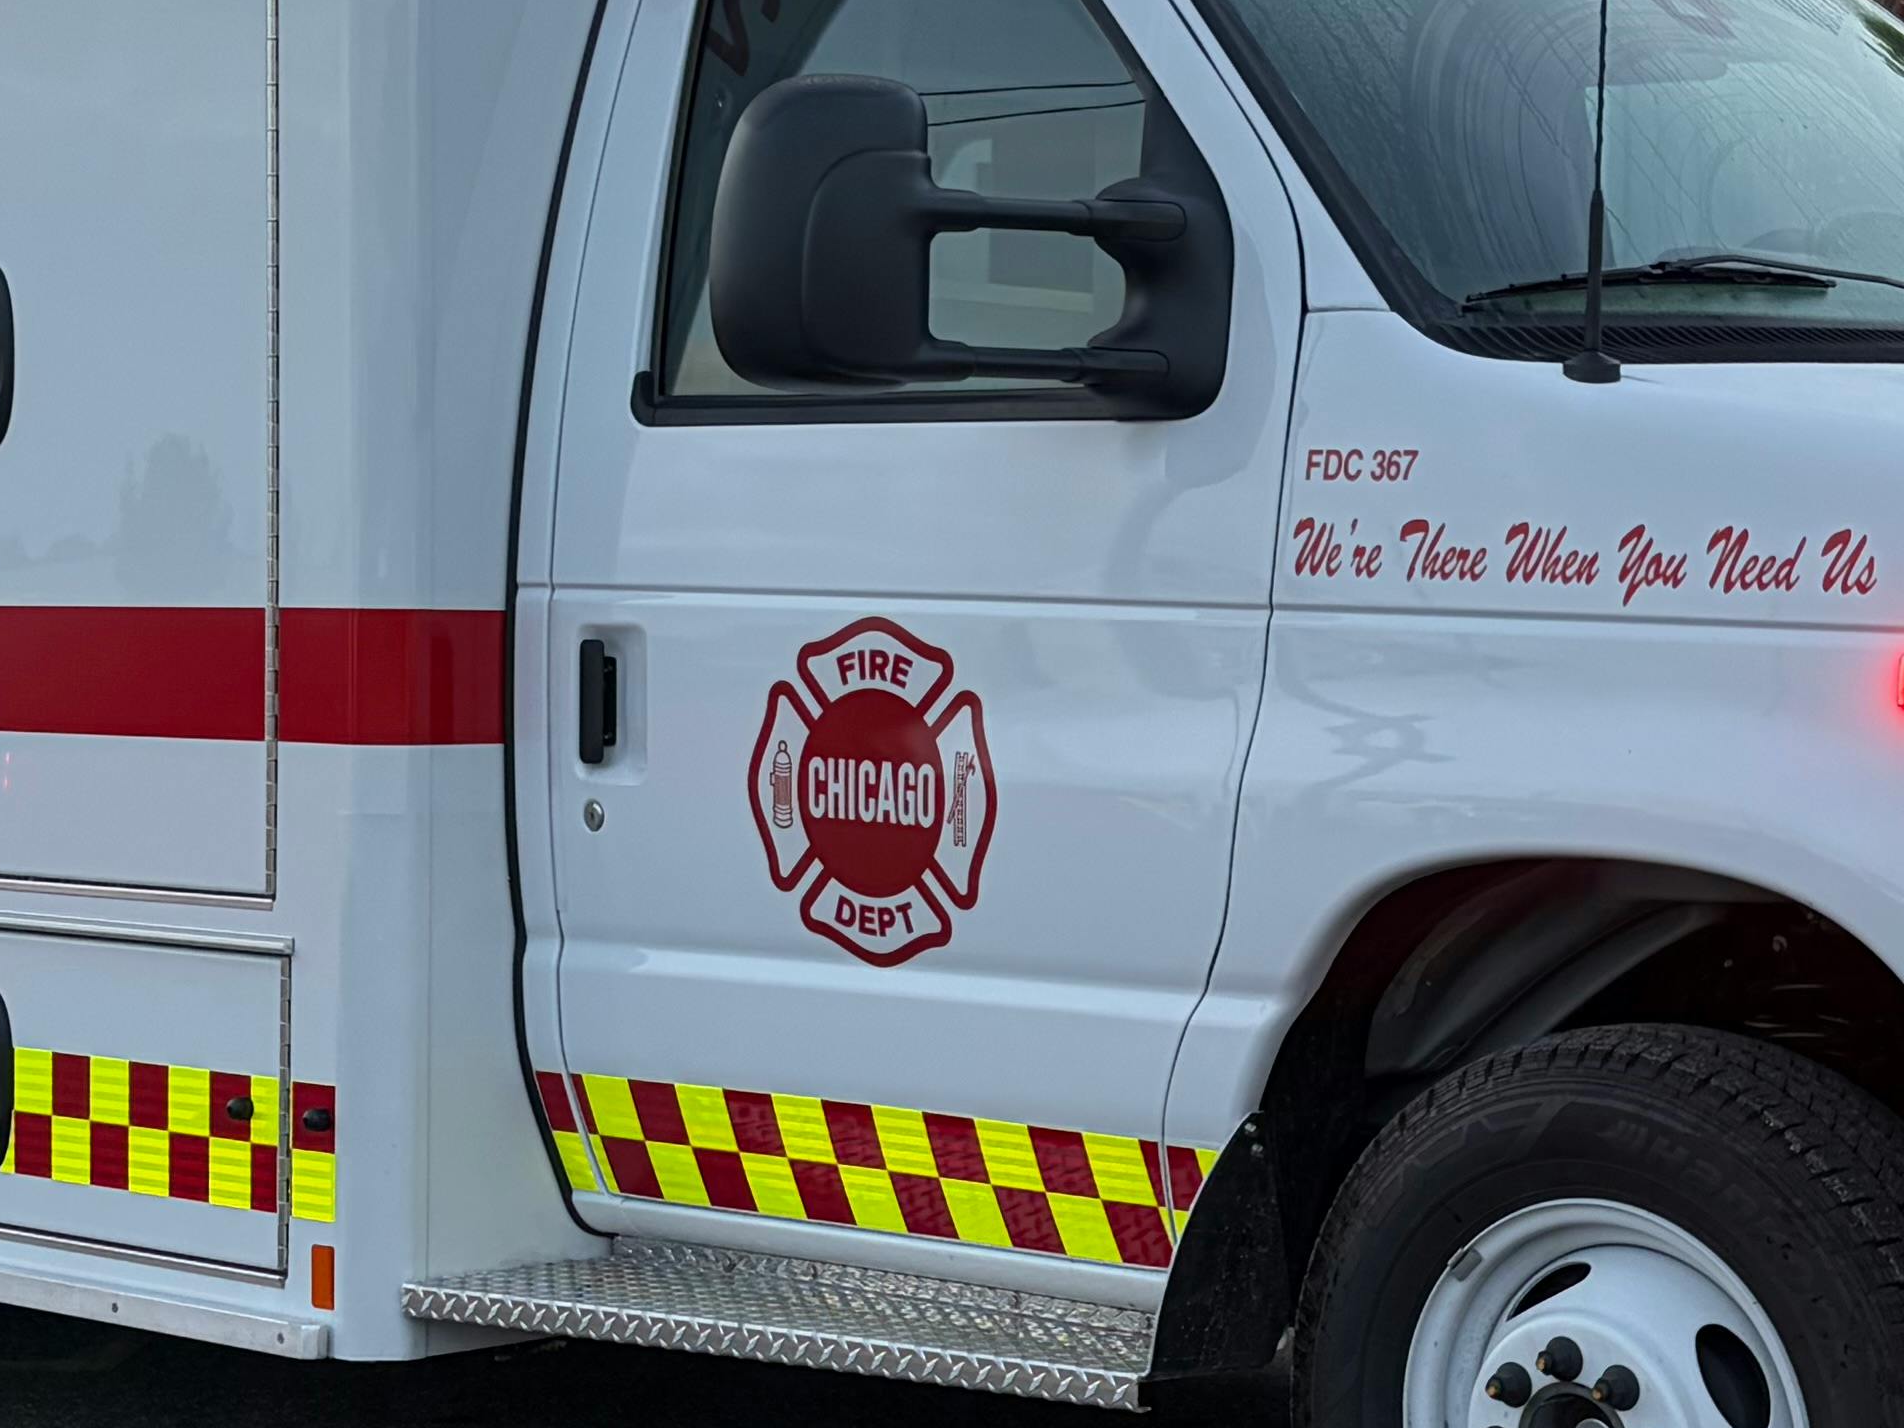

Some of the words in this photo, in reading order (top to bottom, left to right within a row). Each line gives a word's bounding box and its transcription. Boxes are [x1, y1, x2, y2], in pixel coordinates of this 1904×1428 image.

[1304, 449, 1364, 482] FDC
[1370, 449, 1419, 482] 367
[1292, 517, 1383, 579] We're
[1399, 518, 1488, 584] There
[1503, 521, 1601, 587] When
[1616, 523, 1689, 607] You
[1705, 524, 1806, 593] Need
[1820, 528, 1878, 597] Us
[836, 649, 914, 689] FIRE
[807, 756, 937, 830] CHICAGO
[834, 894, 916, 937] DEPT
